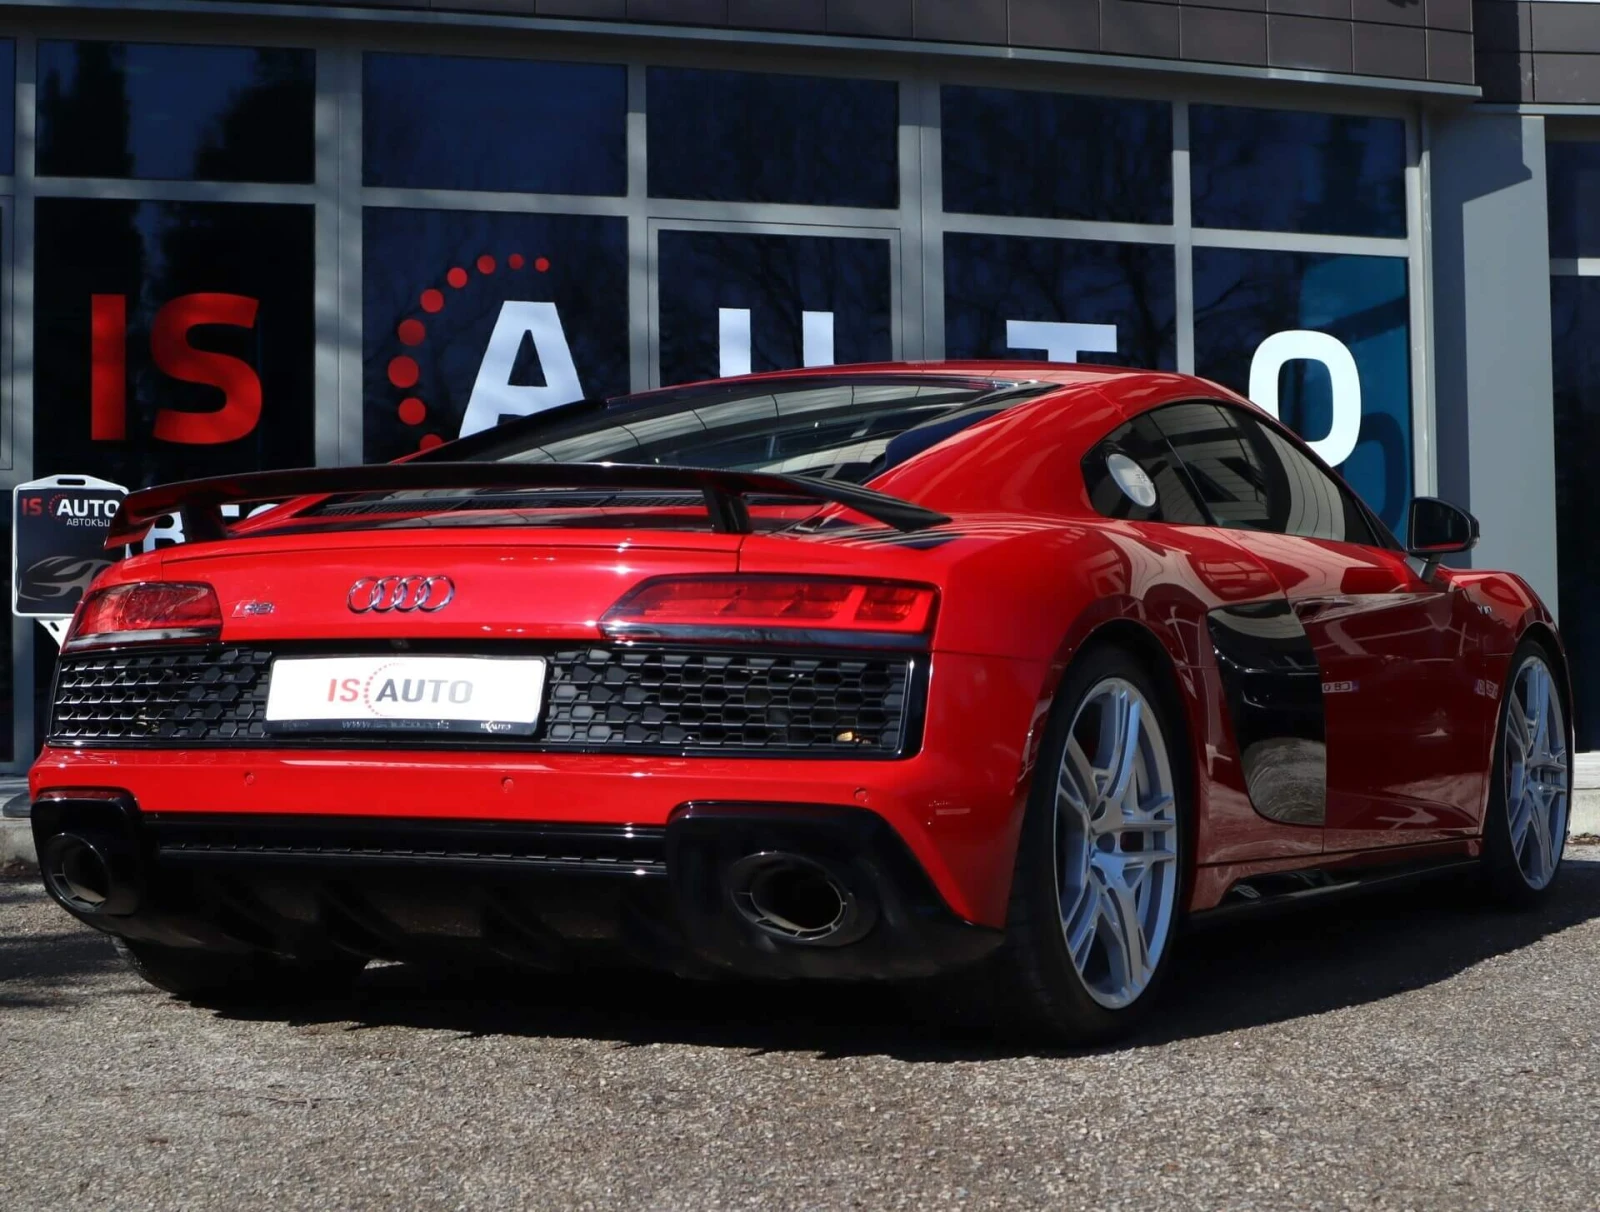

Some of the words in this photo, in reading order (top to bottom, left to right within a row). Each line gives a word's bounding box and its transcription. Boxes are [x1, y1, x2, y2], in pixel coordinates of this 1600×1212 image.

[90, 292, 263, 445] IS
[22, 498, 42, 516] IS
[56, 499, 120, 518] AUTO
[327, 679, 360, 702] IS
[375, 678, 474, 704] AUTO
